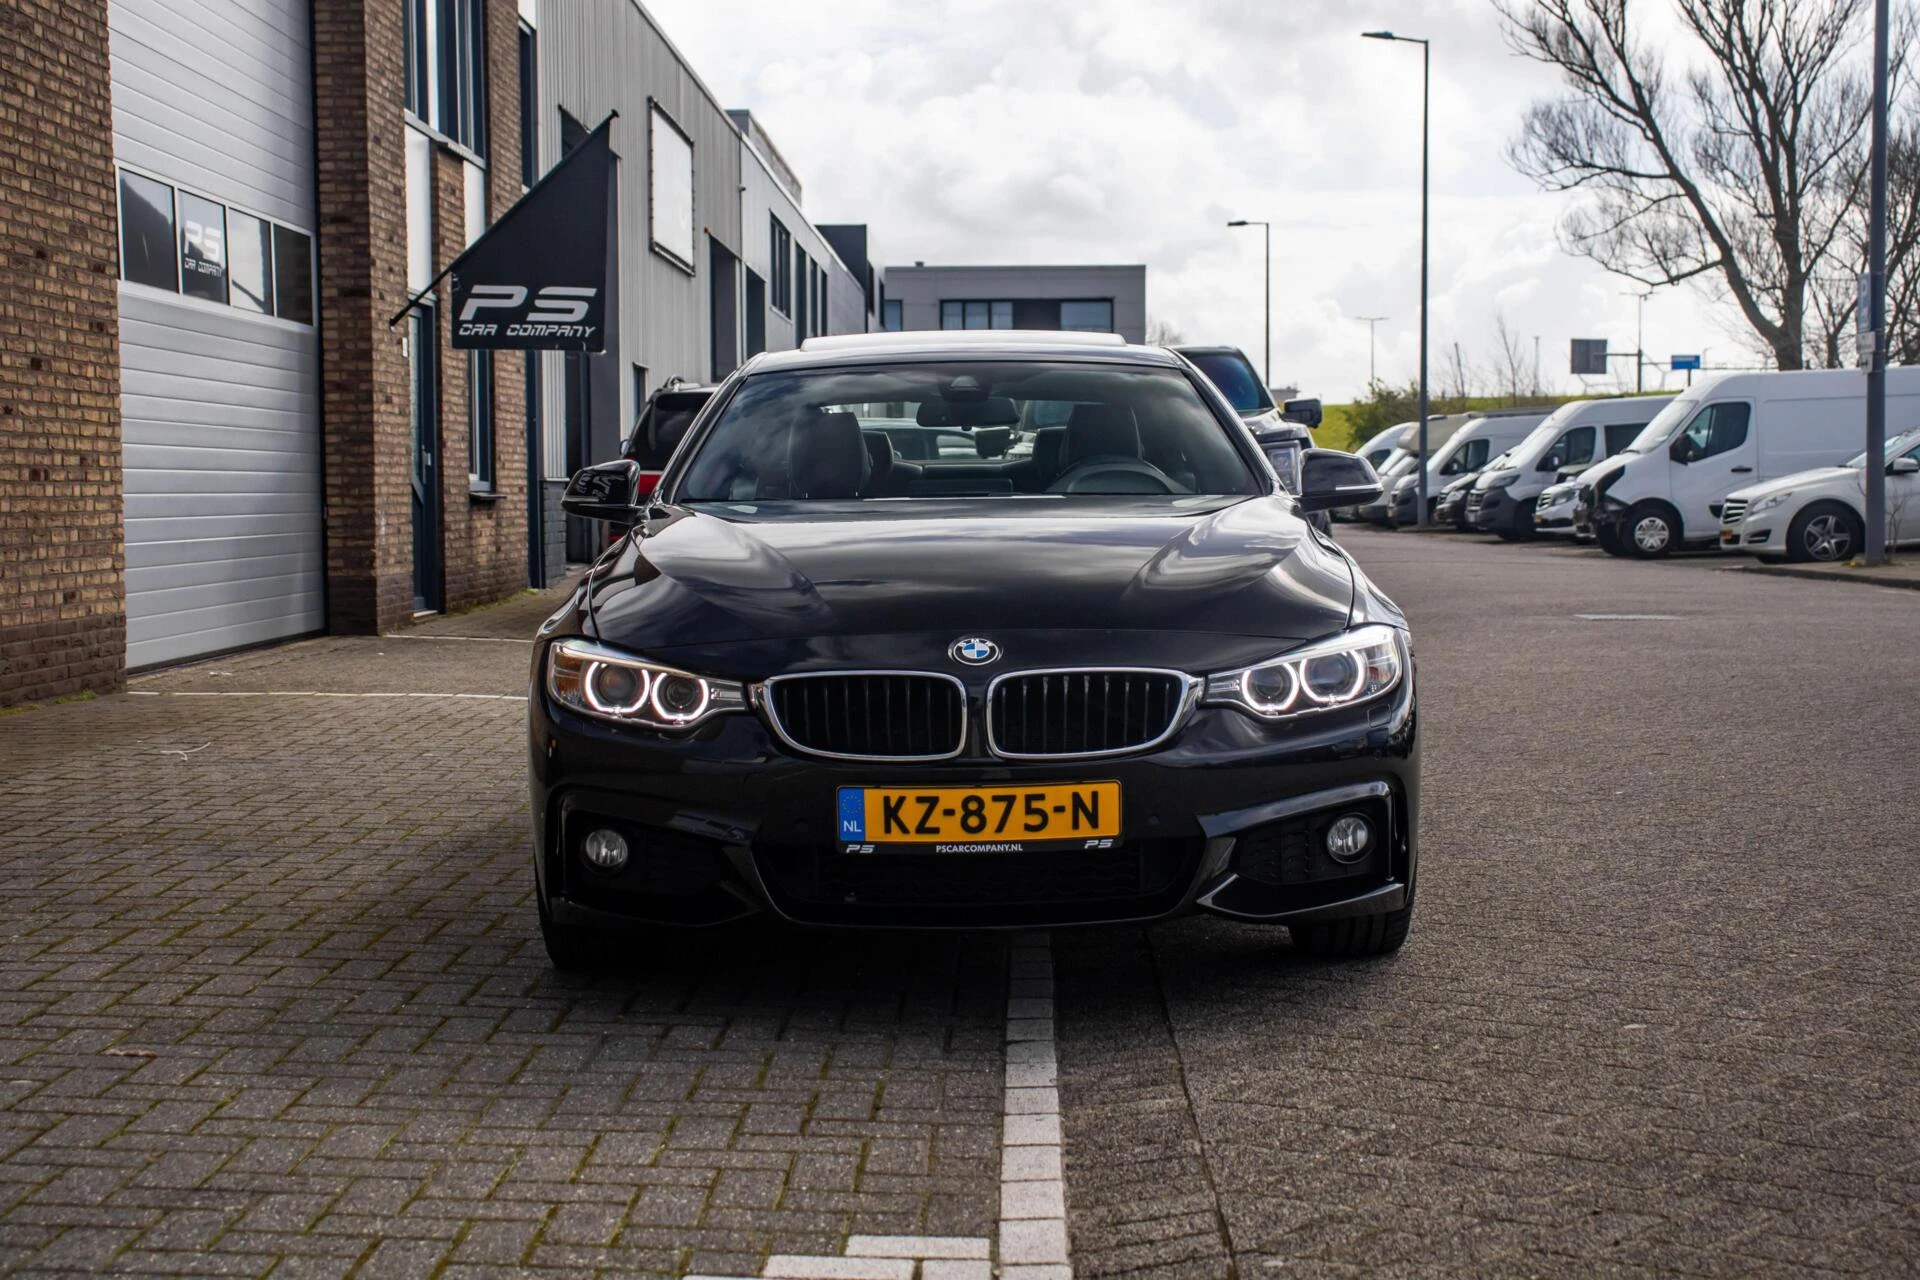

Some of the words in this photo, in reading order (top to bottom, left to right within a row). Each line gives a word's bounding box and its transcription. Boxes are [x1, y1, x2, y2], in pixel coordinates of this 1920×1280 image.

[184, 220, 221, 262] PS
[184, 257, 196, 271] CAR
[459, 284, 597, 322] PS
[459, 324, 498, 336] CAR
[506, 324, 596, 338] COMPANY
[883, 791, 1099, 834] KZ-875-N
[843, 820, 862, 833] NL
[846, 844, 875, 854] PS
[936, 843, 1023, 853] PSCARCOMPANY.NL
[1084, 839, 1113, 849] PS
